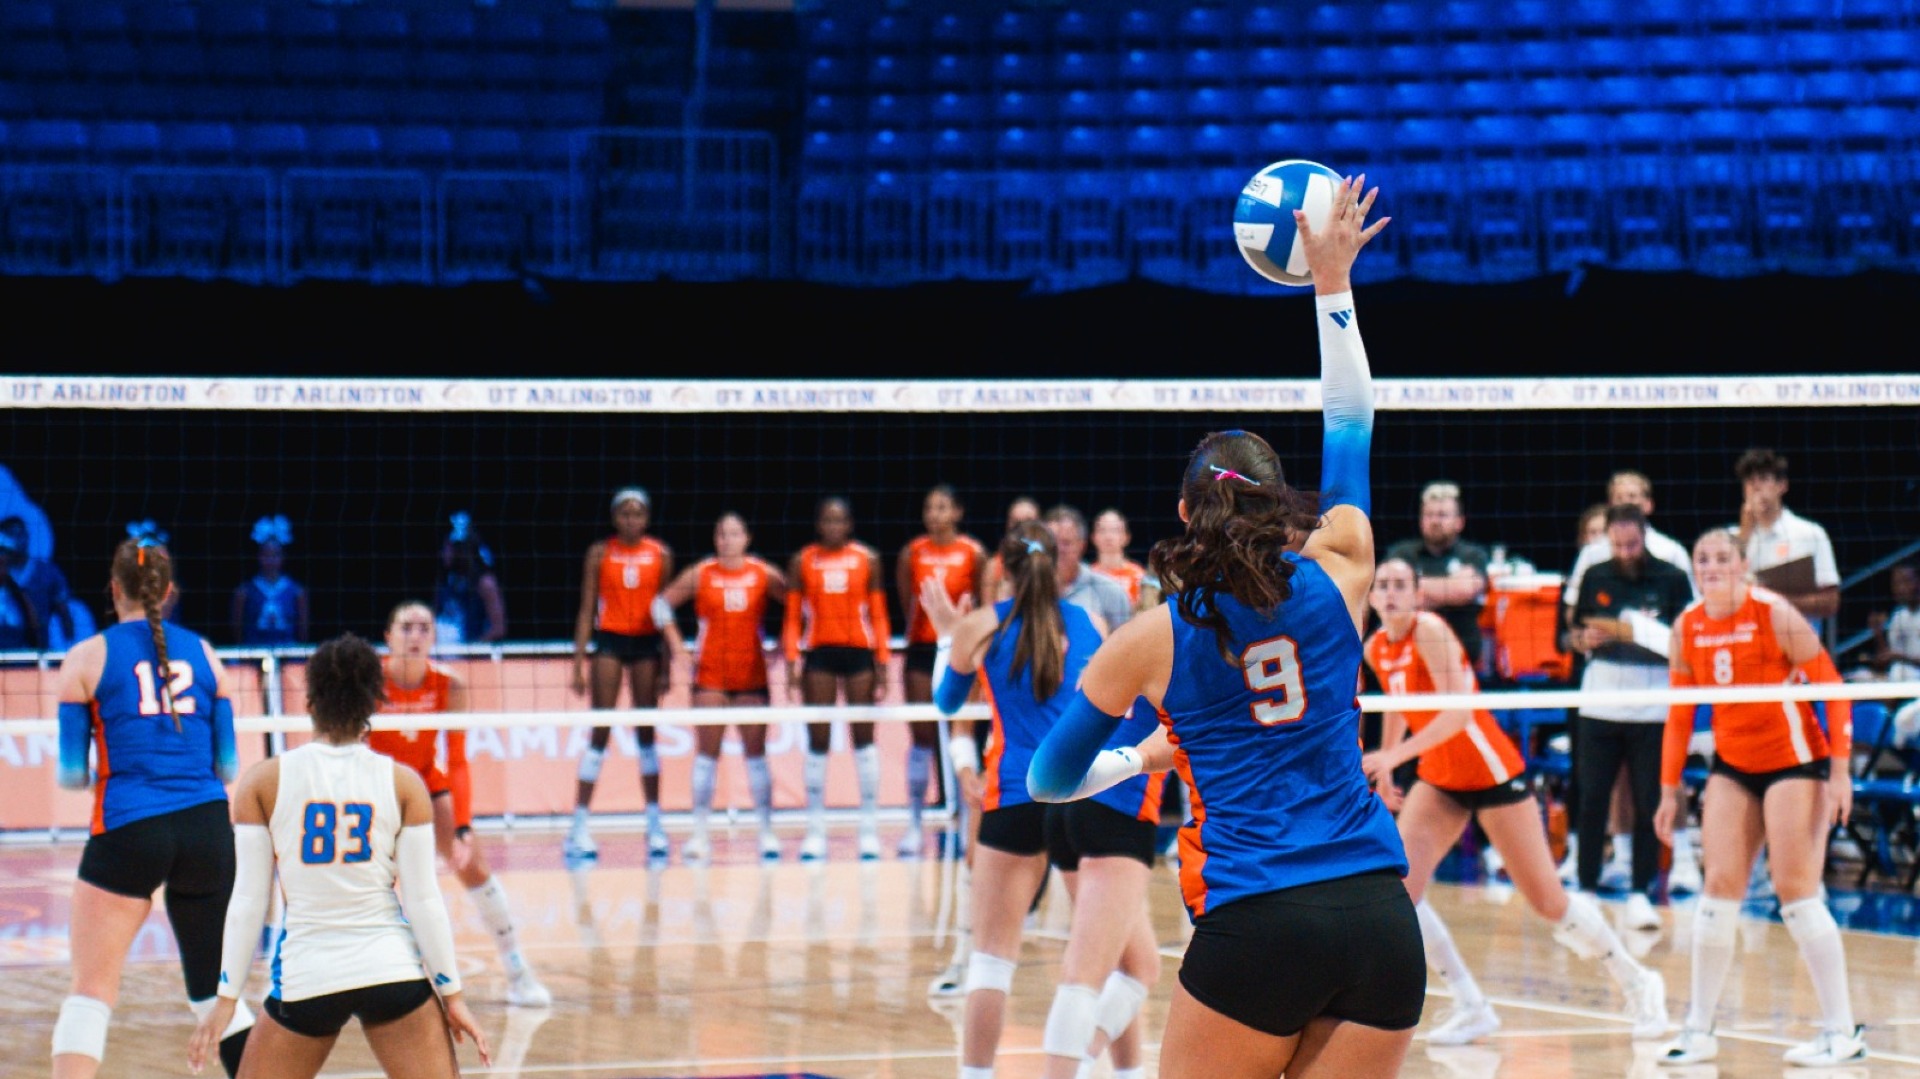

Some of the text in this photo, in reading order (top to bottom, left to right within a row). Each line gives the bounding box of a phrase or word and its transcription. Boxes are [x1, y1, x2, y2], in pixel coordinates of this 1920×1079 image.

[12, 383, 187, 402] UT ARLINGTON
[254, 385, 423, 404] UT ARLINGTON
[487, 387, 653, 405] UT ARLINGTON
[715, 388, 876, 406] UT ARLINGTON
[936, 387, 1094, 405] UT ARLINGTON
[1152, 387, 1306, 404] UT ARLINGTON
[1402, 385, 1515, 402] ARLINGTON
[1573, 385, 1719, 401] UT ARLINGTON
[1776, 382, 1802, 399] UT
[1713, 648, 1734, 685] 8
[132, 659, 196, 716] 12
[1240, 634, 1309, 727] 9
[299, 799, 376, 865] 83
